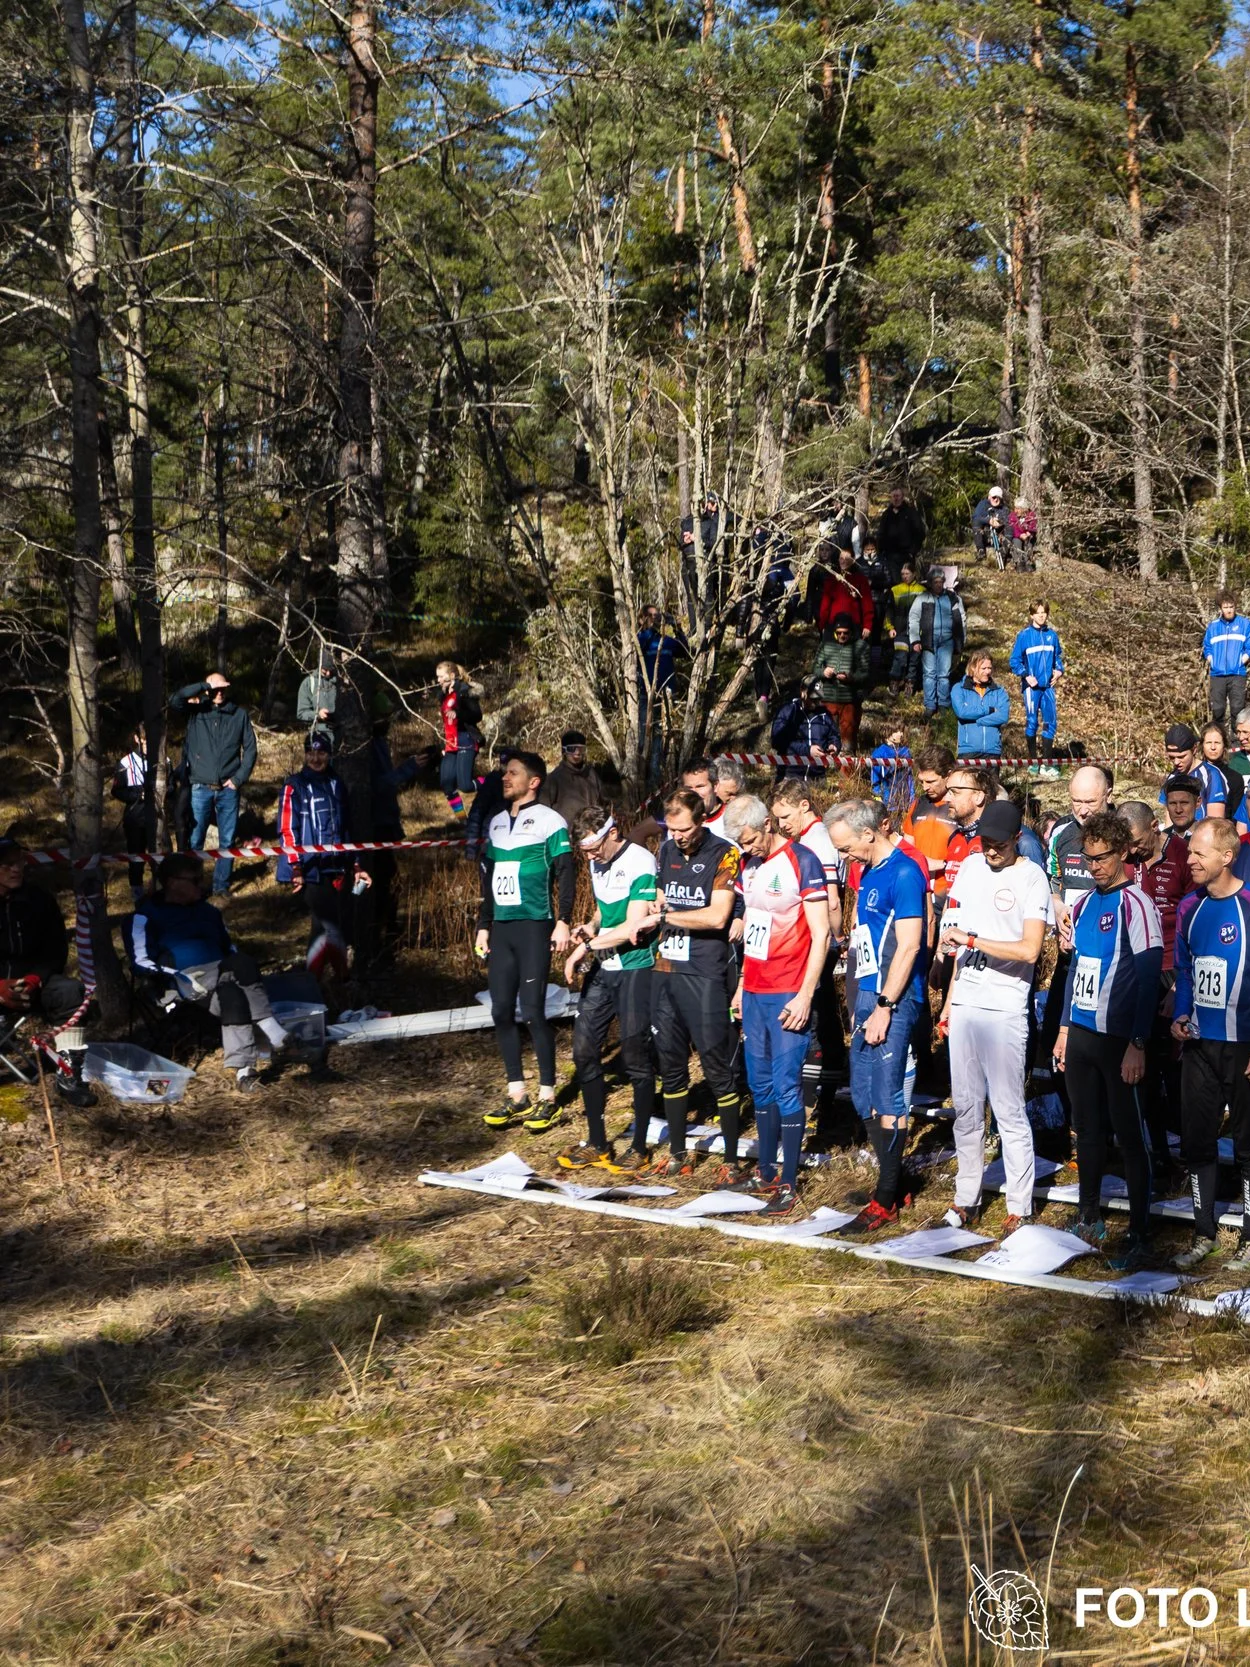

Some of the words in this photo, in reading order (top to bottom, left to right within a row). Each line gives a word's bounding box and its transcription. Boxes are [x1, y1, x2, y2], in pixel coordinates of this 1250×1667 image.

[497, 876, 515, 895] 220
[664, 881, 705, 900] JÄRLA
[664, 928, 685, 950] 218
[747, 923, 767, 948] 217
[964, 947, 988, 971] 215
[1075, 972, 1094, 998] 214
[1198, 969, 1221, 996] 213
[1191, 1174, 1201, 1209] TRIMTEX
